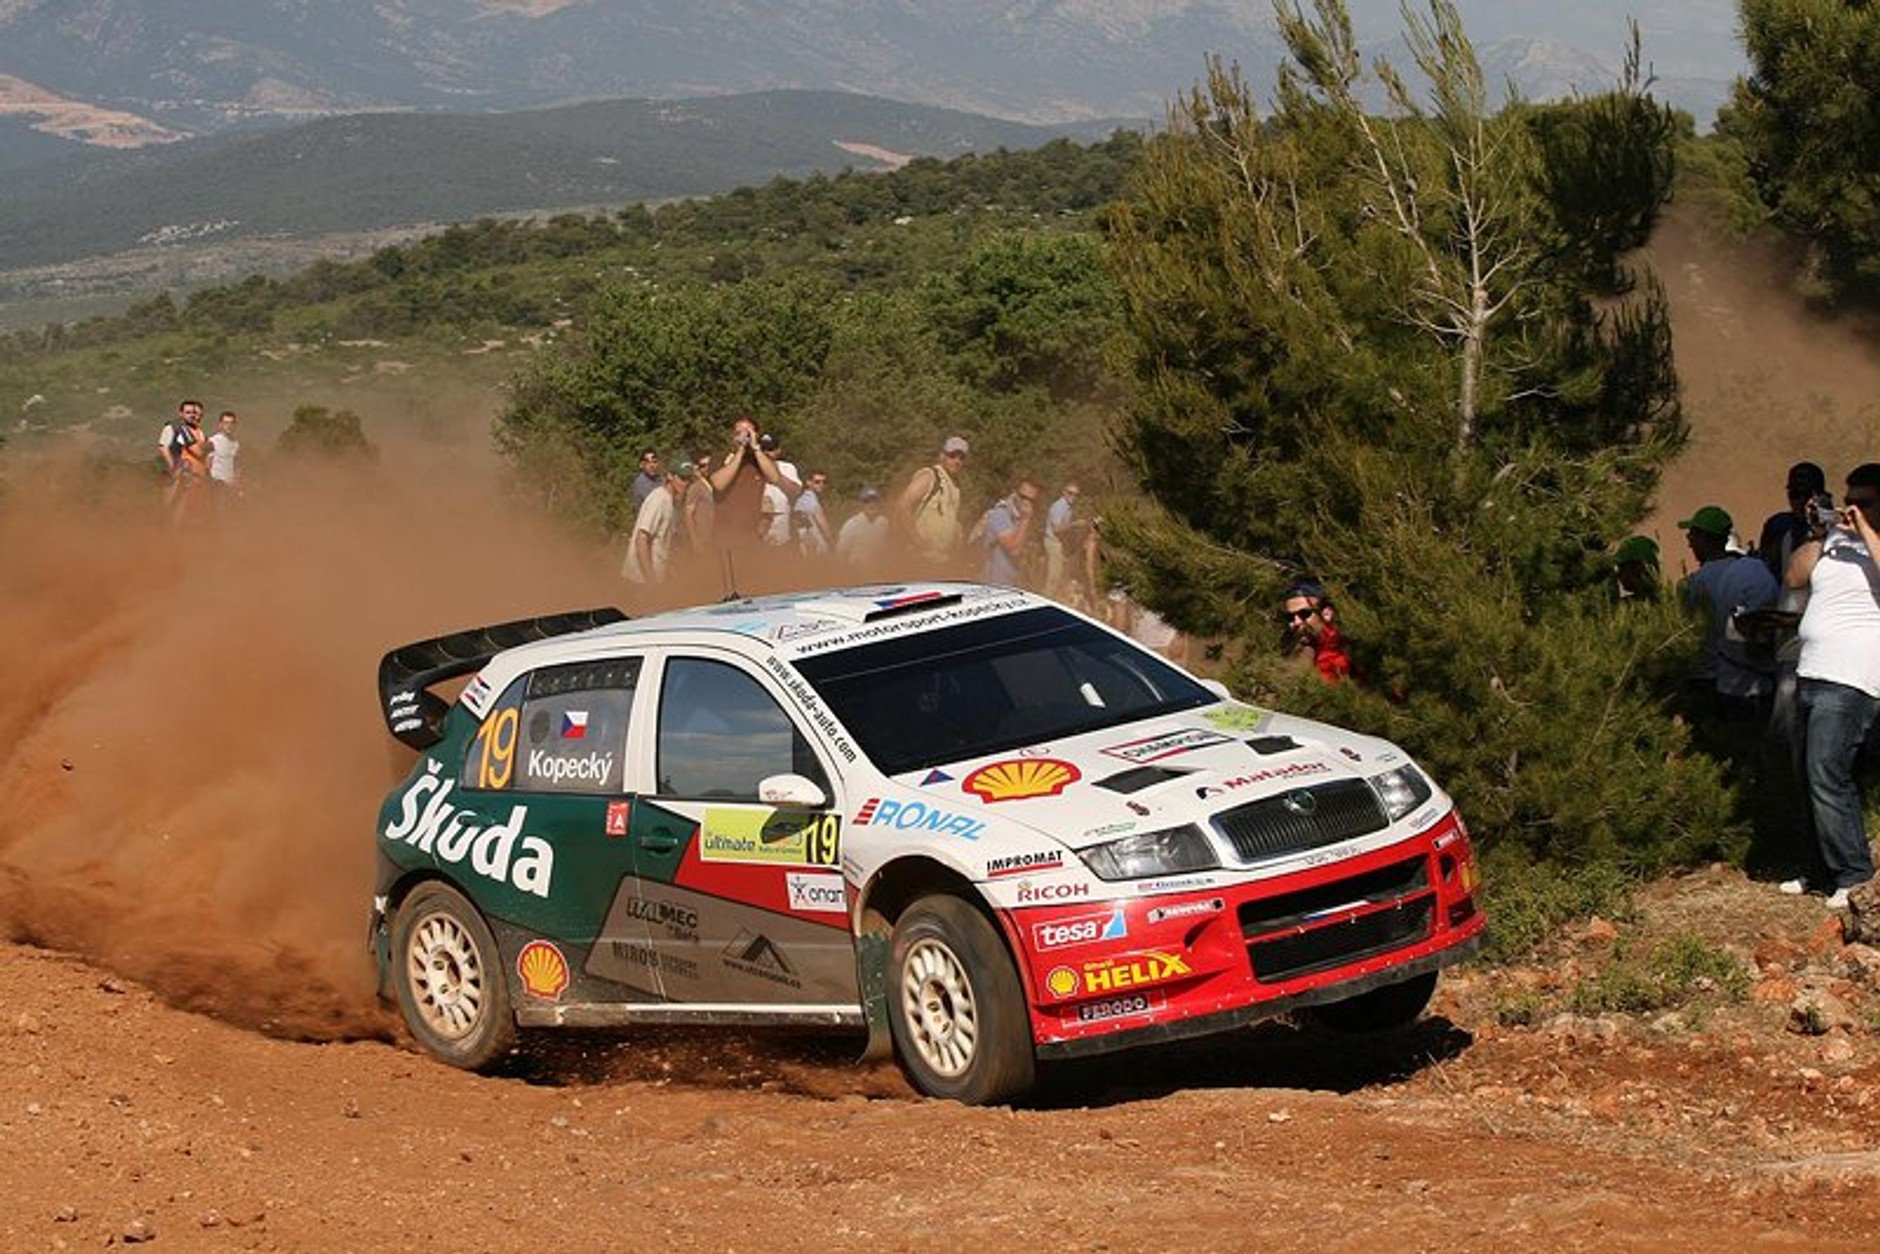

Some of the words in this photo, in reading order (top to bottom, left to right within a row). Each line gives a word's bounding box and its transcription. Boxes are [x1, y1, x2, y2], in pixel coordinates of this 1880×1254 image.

[477, 707, 520, 790] 19
[528, 748, 614, 786] Kopecký
[804, 814, 838, 865] 19
[871, 799, 987, 841] RONAL
[987, 850, 1063, 872] IMPROMAT
[1017, 883, 1089, 902] RICOH
[1040, 921, 1098, 945] tesa
[1084, 951, 1192, 993] HELIX
